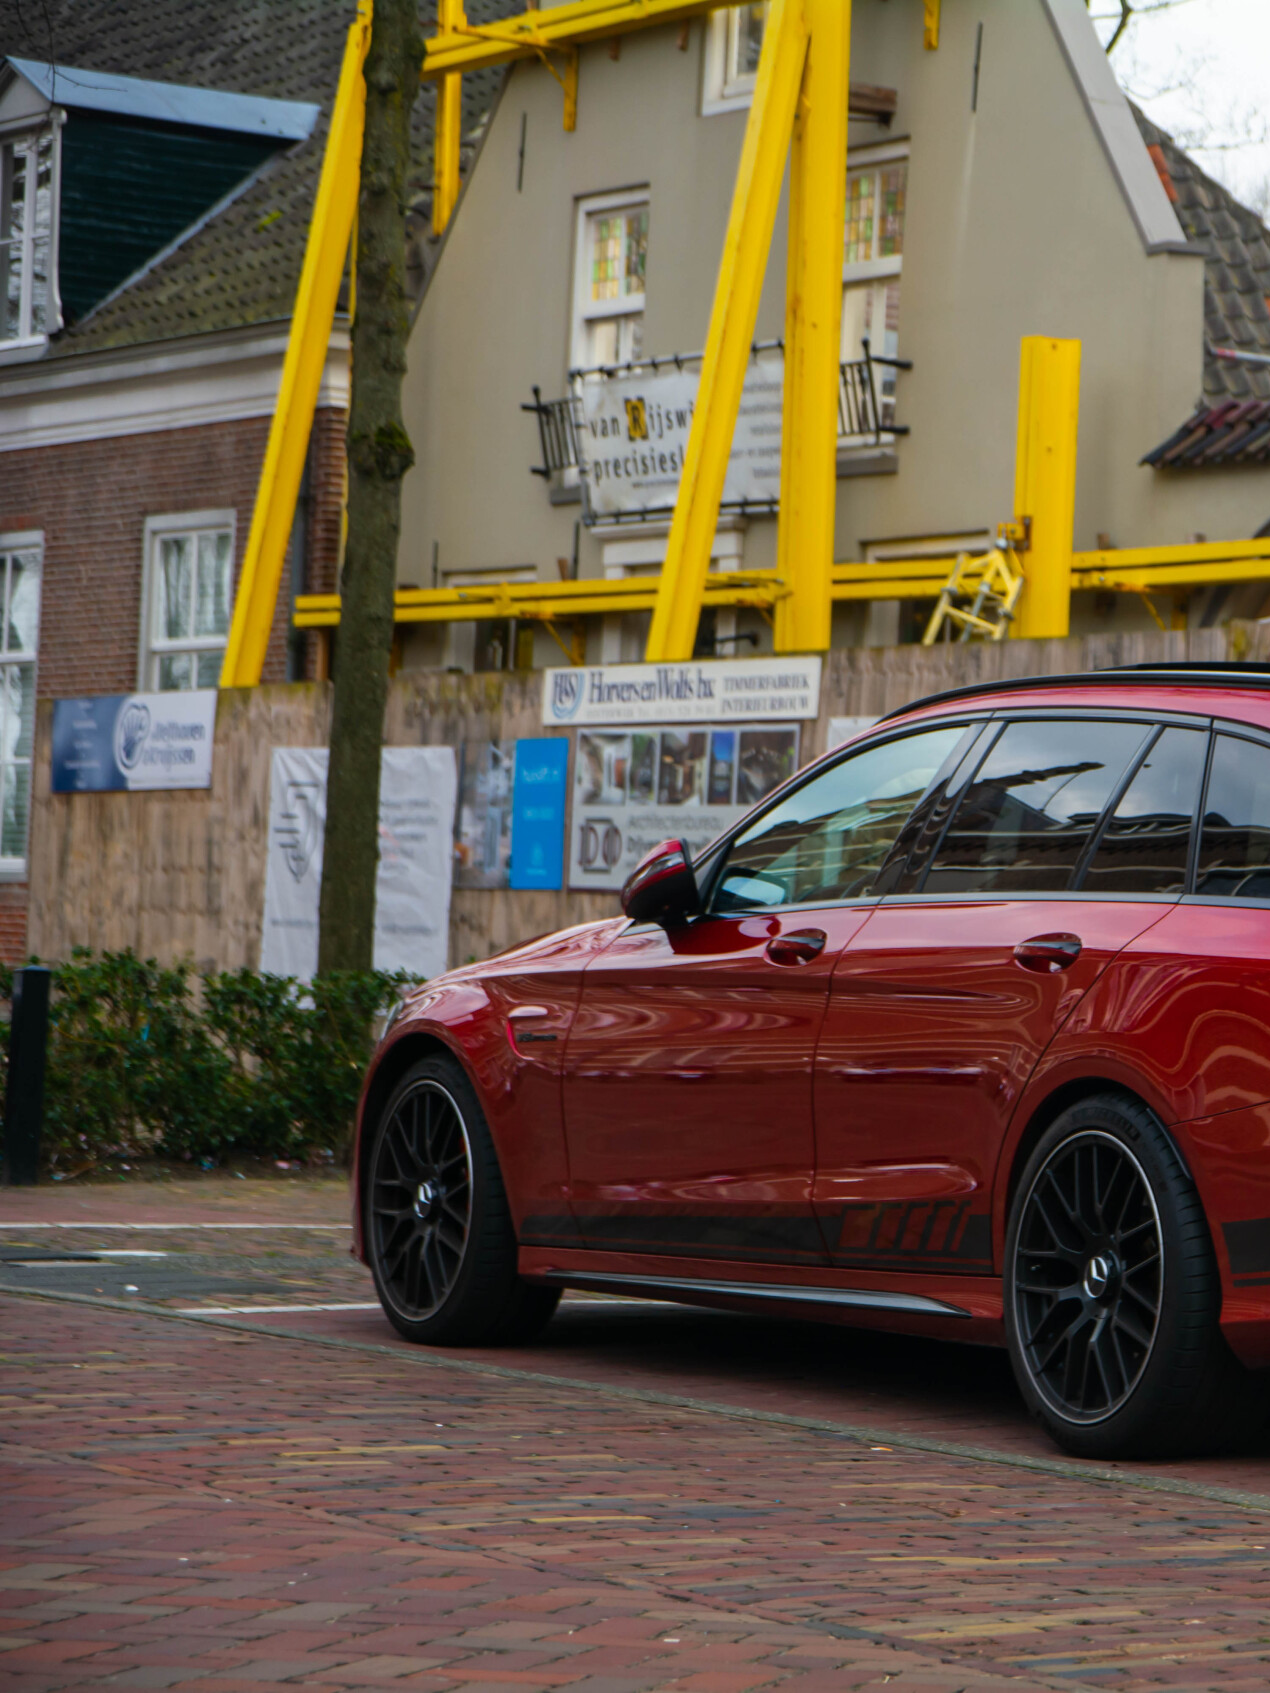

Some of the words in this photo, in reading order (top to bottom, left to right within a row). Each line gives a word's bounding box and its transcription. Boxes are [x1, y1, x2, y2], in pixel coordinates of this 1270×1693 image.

[590, 414, 620, 439] van
[628, 398, 694, 440] Rijswi
[593, 443, 685, 487] precisiesl
[723, 673, 810, 691] TIMMERFABRIEK
[721, 694, 809, 712] INTERIEURBOUW
